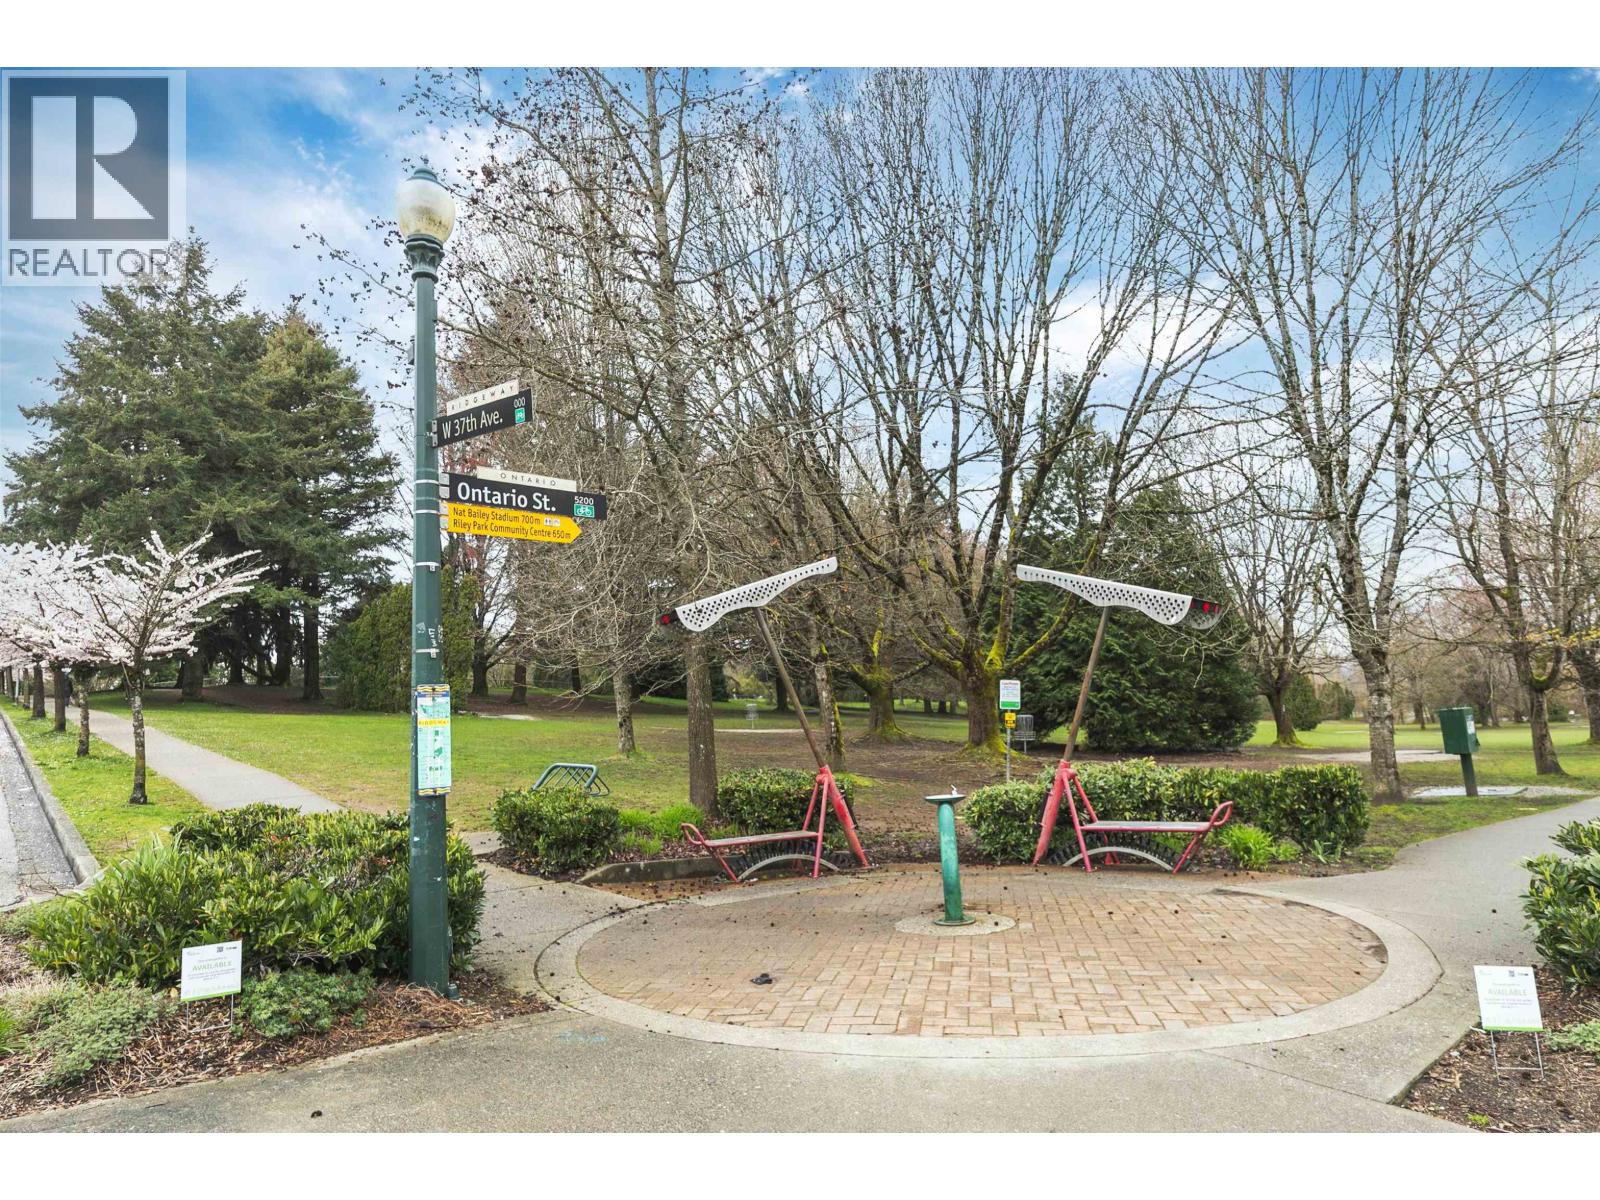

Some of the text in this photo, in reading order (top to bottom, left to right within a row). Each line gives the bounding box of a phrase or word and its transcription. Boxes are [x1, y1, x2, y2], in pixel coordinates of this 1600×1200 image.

[451, 385, 513, 410] RIDGEWAY
[513, 397, 526, 408] 000
[442, 410, 503, 439] W 37th Ave.
[500, 473, 557, 486] ONTARIO
[457, 482, 556, 511] Ontario St.
[574, 496, 594, 505] 5200
[453, 507, 466, 517] Nat
[468, 508, 490, 521] Bailey
[491, 511, 519, 523] Stadium
[453, 519, 471, 531] Riley
[473, 521, 488, 531] Park
[490, 523, 528, 537] Community
[530, 526, 552, 537] Centre
